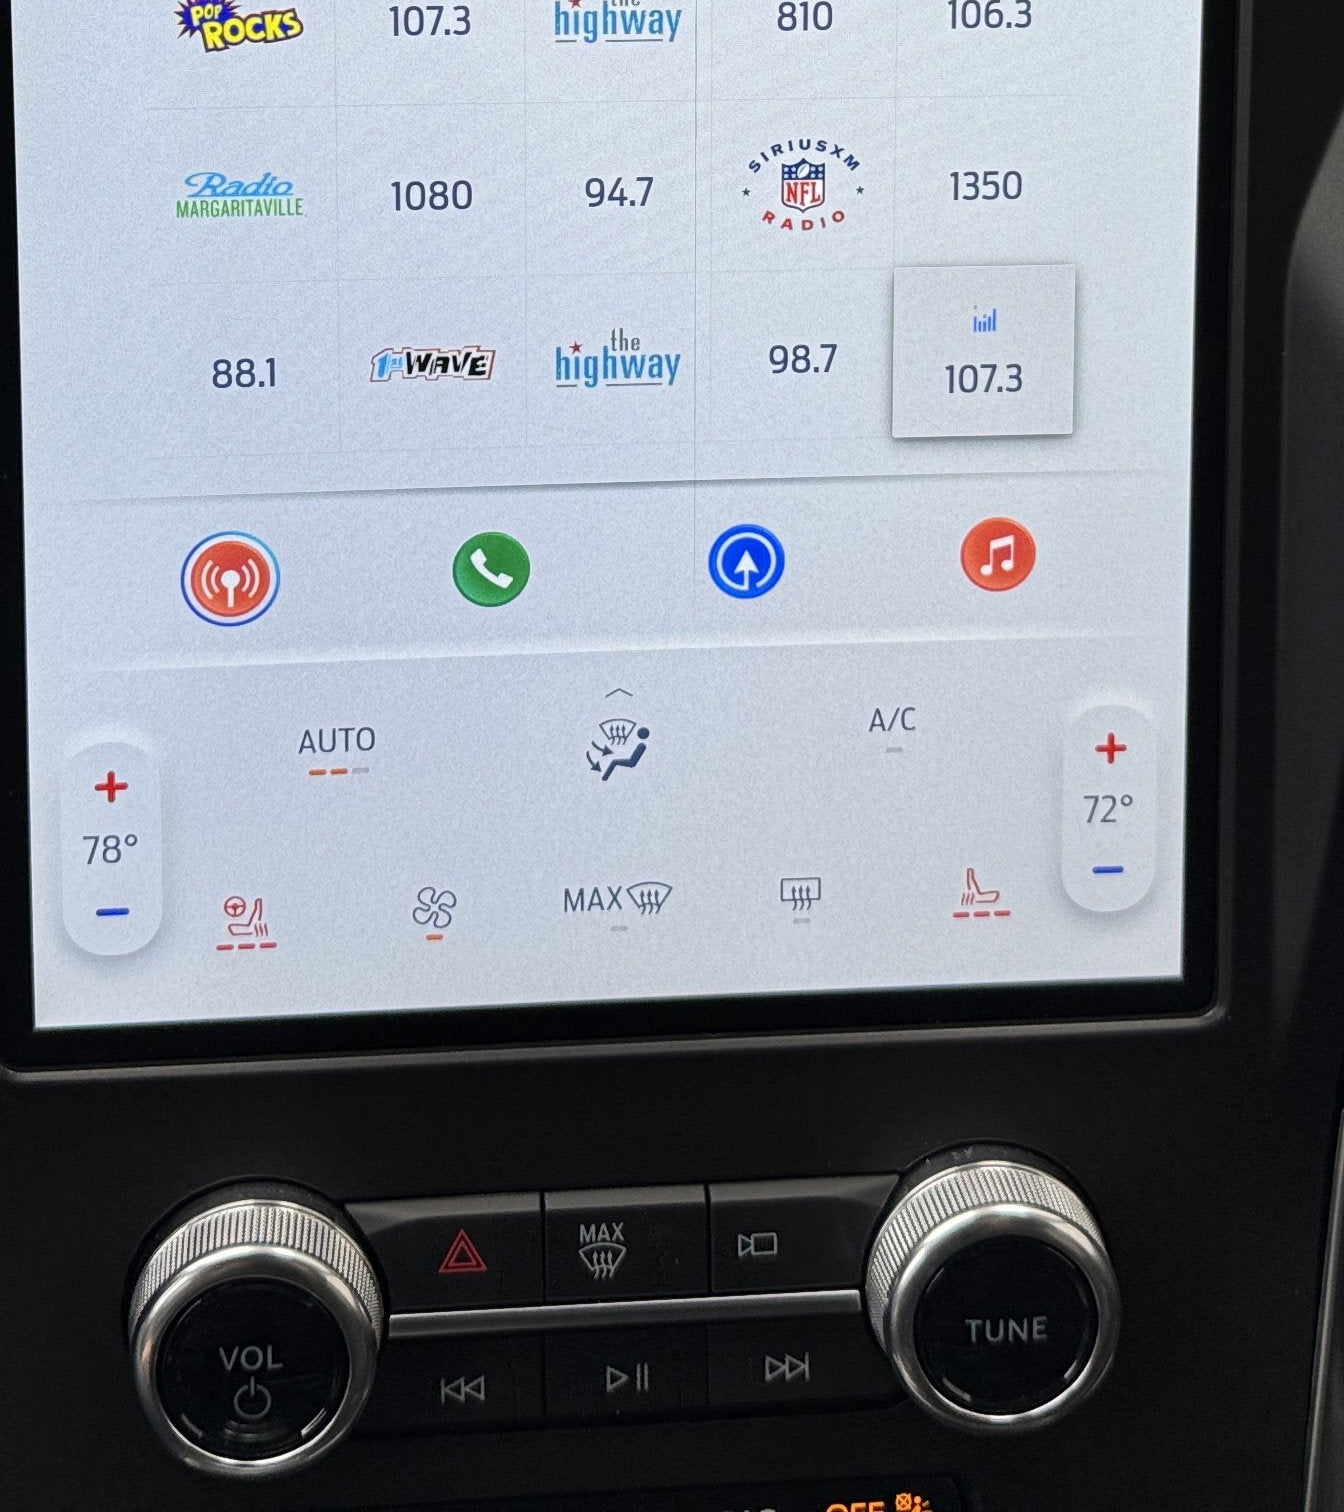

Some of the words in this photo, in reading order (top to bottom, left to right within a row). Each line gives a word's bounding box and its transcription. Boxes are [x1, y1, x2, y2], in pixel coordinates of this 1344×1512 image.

[190, 3, 223, 27] POP
[388, 4, 471, 37] 107.3
[554, 0, 683, 44] highway
[777, 1, 834, 31] 810
[201, 11, 303, 50] ROCKS
[748, 138, 861, 173] SIRIUSXM
[184, 171, 294, 198] Radio
[390, 180, 473, 211] 1080
[584, 177, 654, 208] 94.7
[785, 181, 821, 206] NFL
[949, 171, 1023, 201] 1350
[176, 198, 304, 219] MARGARITAVILLE
[761, 210, 845, 231] RADIO
[610, 328, 641, 352] the
[211, 359, 277, 389] 88.1
[405, 351, 489, 377] WAVE
[555, 345, 681, 388] highway
[768, 344, 838, 374] 98.7
[944, 364, 1023, 394] 107.3
[868, 707, 916, 734] A/C
[298, 727, 376, 754] AUTO
[1083, 794, 1134, 825] 72°
[82, 833, 139, 865] 78°
[564, 886, 623, 913] MAX
[579, 1222, 625, 1244] MAX
[965, 1316, 1049, 1345] TUNE
[219, 1345, 283, 1372] VOL
